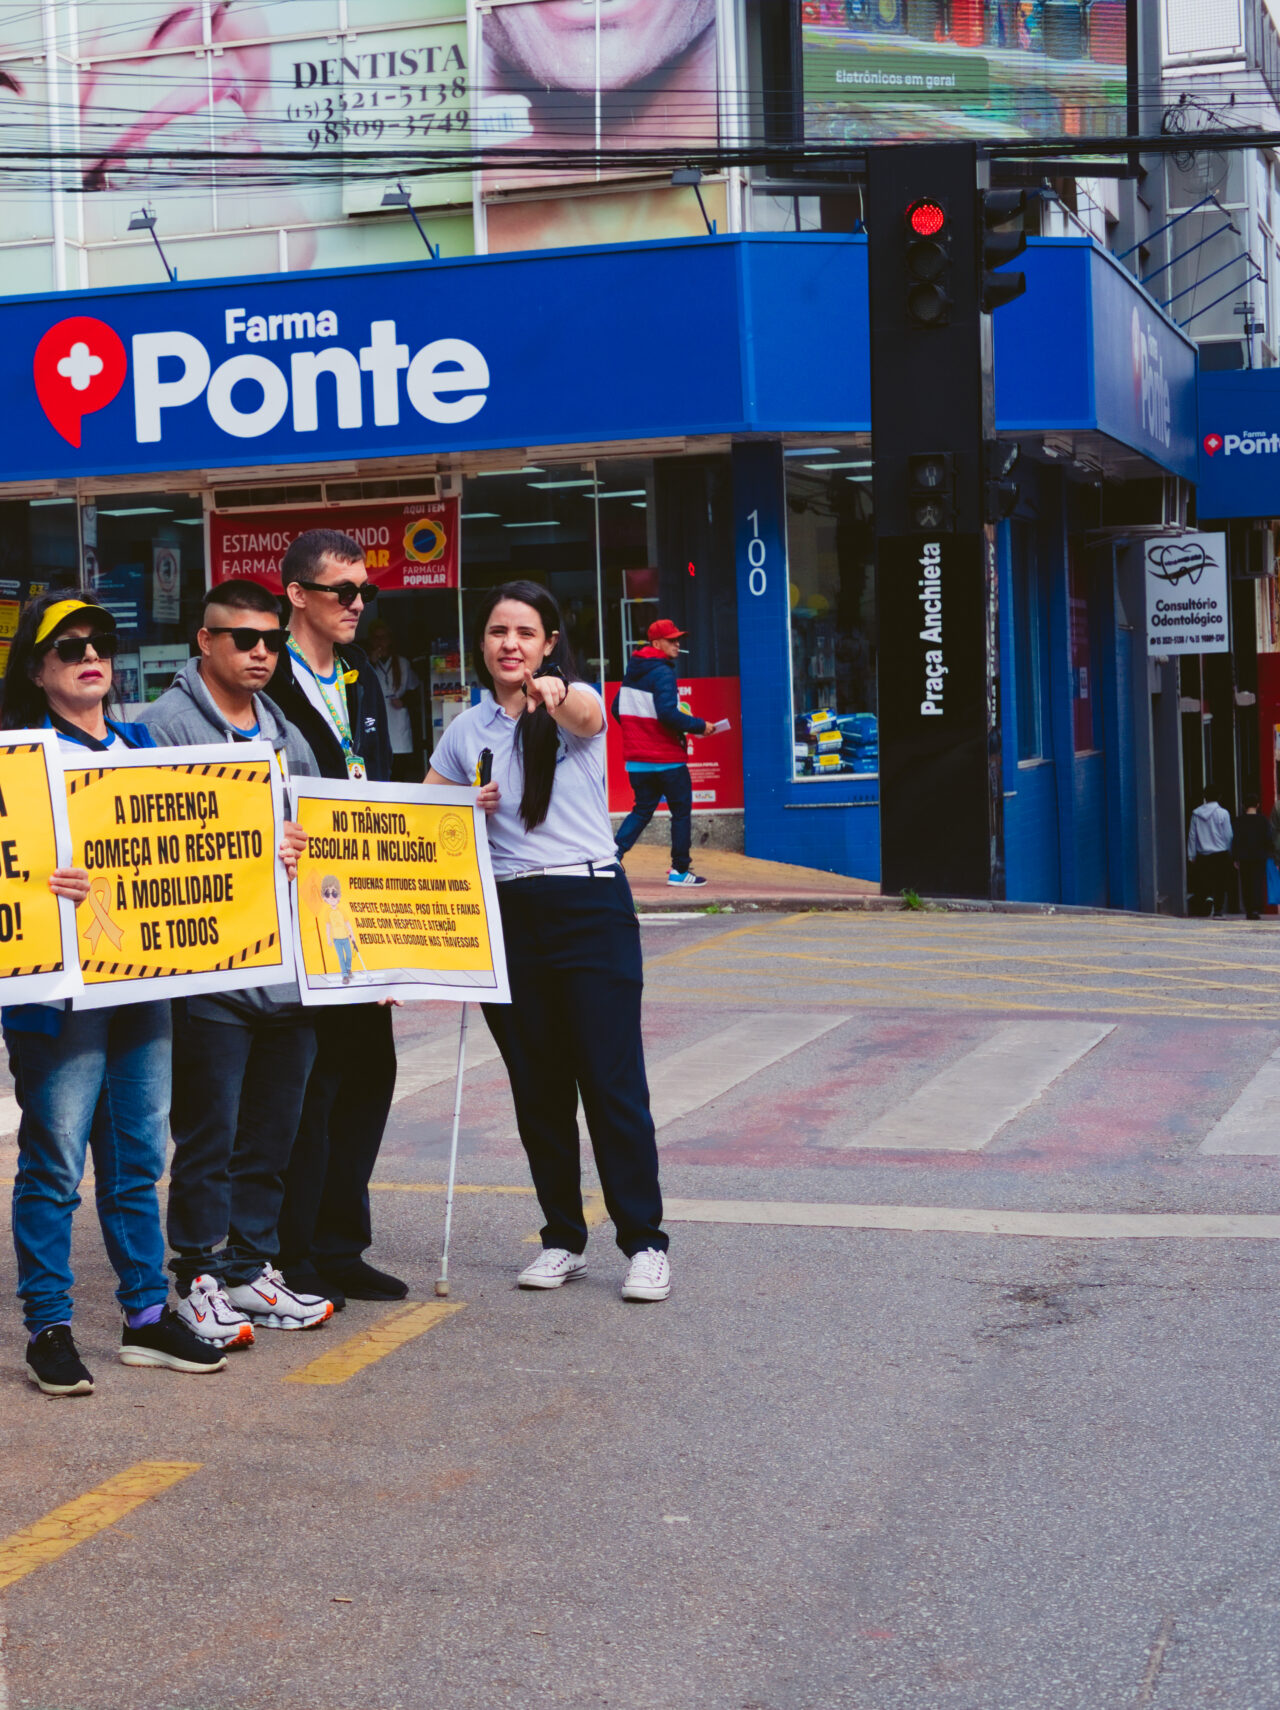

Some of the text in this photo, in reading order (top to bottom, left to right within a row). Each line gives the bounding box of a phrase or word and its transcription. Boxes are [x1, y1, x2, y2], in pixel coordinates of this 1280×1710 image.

[293, 44, 468, 89] DENTISTA
[836, 69, 955, 90] Eletrônicos em geral
[225, 307, 338, 344] Farma
[132, 320, 491, 443] Ponte
[1224, 433, 1280, 456] Pont
[1243, 430, 1267, 438] Farma
[403, 503, 446, 515] AQUI TEM
[222, 532, 291, 553] ESTAMOS
[747, 509, 767, 596] 100
[403, 564, 446, 575] FARMÁCIA
[403, 574, 446, 586] POPULAR
[1156, 597, 1217, 612] Consultório
[918, 542, 949, 715] Praça Anchieta
[1151, 612, 1223, 627] Odontológico
[115, 791, 219, 829] A DIFERENÇA
[332, 810, 348, 833] NO
[351, 806, 410, 838] TRÂNSITO,
[84, 829, 263, 876] COMEÇA NO RESPEITO
[308, 836, 438, 863] ESCOLHA A INCLUSÃO!
[116, 873, 233, 911] À MOBILIDADE
[349, 877, 472, 892] PEQUENAS ATITUDES SALVAM VIDAS:
[349, 902, 380, 913] RESPEITE
[416, 903, 431, 915] PISO
[432, 901, 448, 915] TÁTIL
[451, 903, 456, 915] E
[457, 903, 480, 915] FAIXAS
[140, 916, 220, 951] DE TODOS
[355, 917, 457, 935] AJUDE COM RESPEITO E ATENÇÃO
[359, 933, 480, 948] REDUZA A VELOCIDADE NAS TRAVESSIAS
